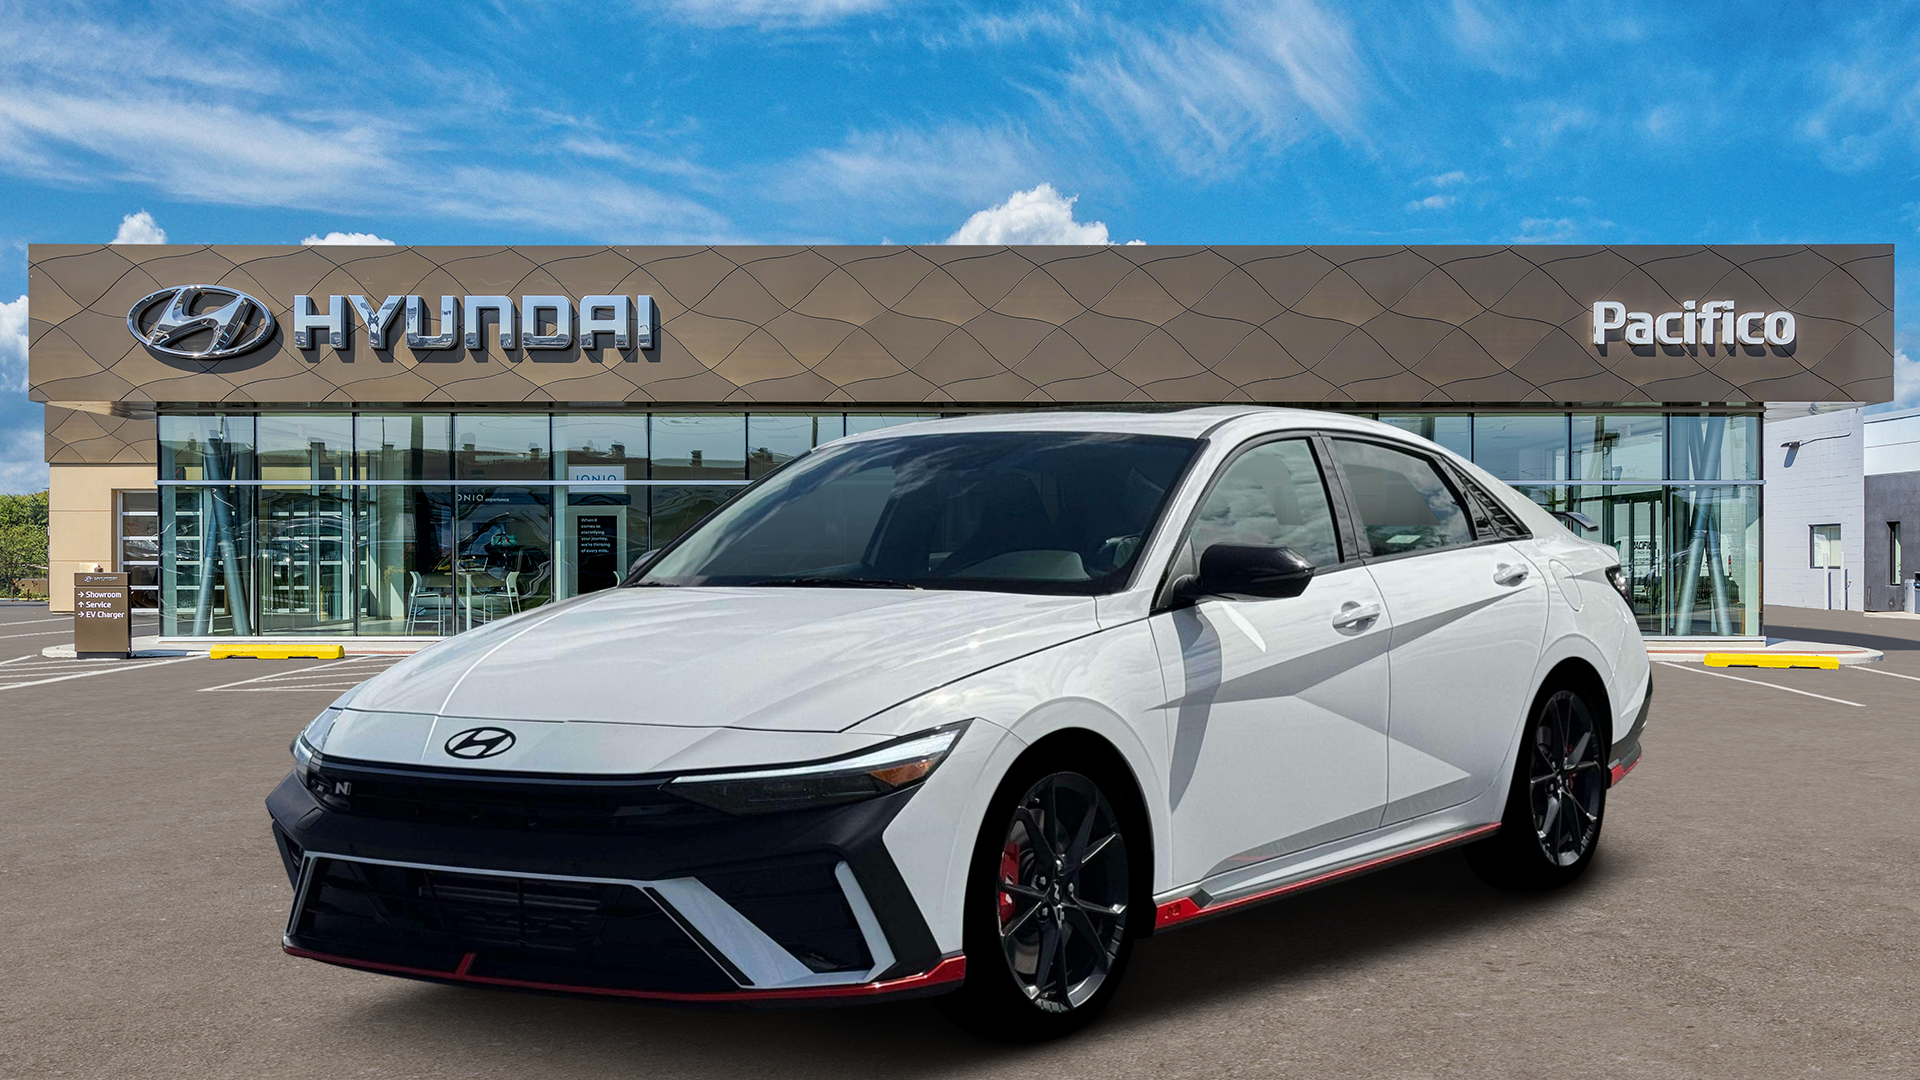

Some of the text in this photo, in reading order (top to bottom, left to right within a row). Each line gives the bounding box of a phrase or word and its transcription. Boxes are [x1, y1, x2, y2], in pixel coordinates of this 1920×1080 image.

[294, 294, 653, 350] HYUNDAI
[1592, 300, 1796, 345] Pacifico
[97, 611, 125, 619] Charger
